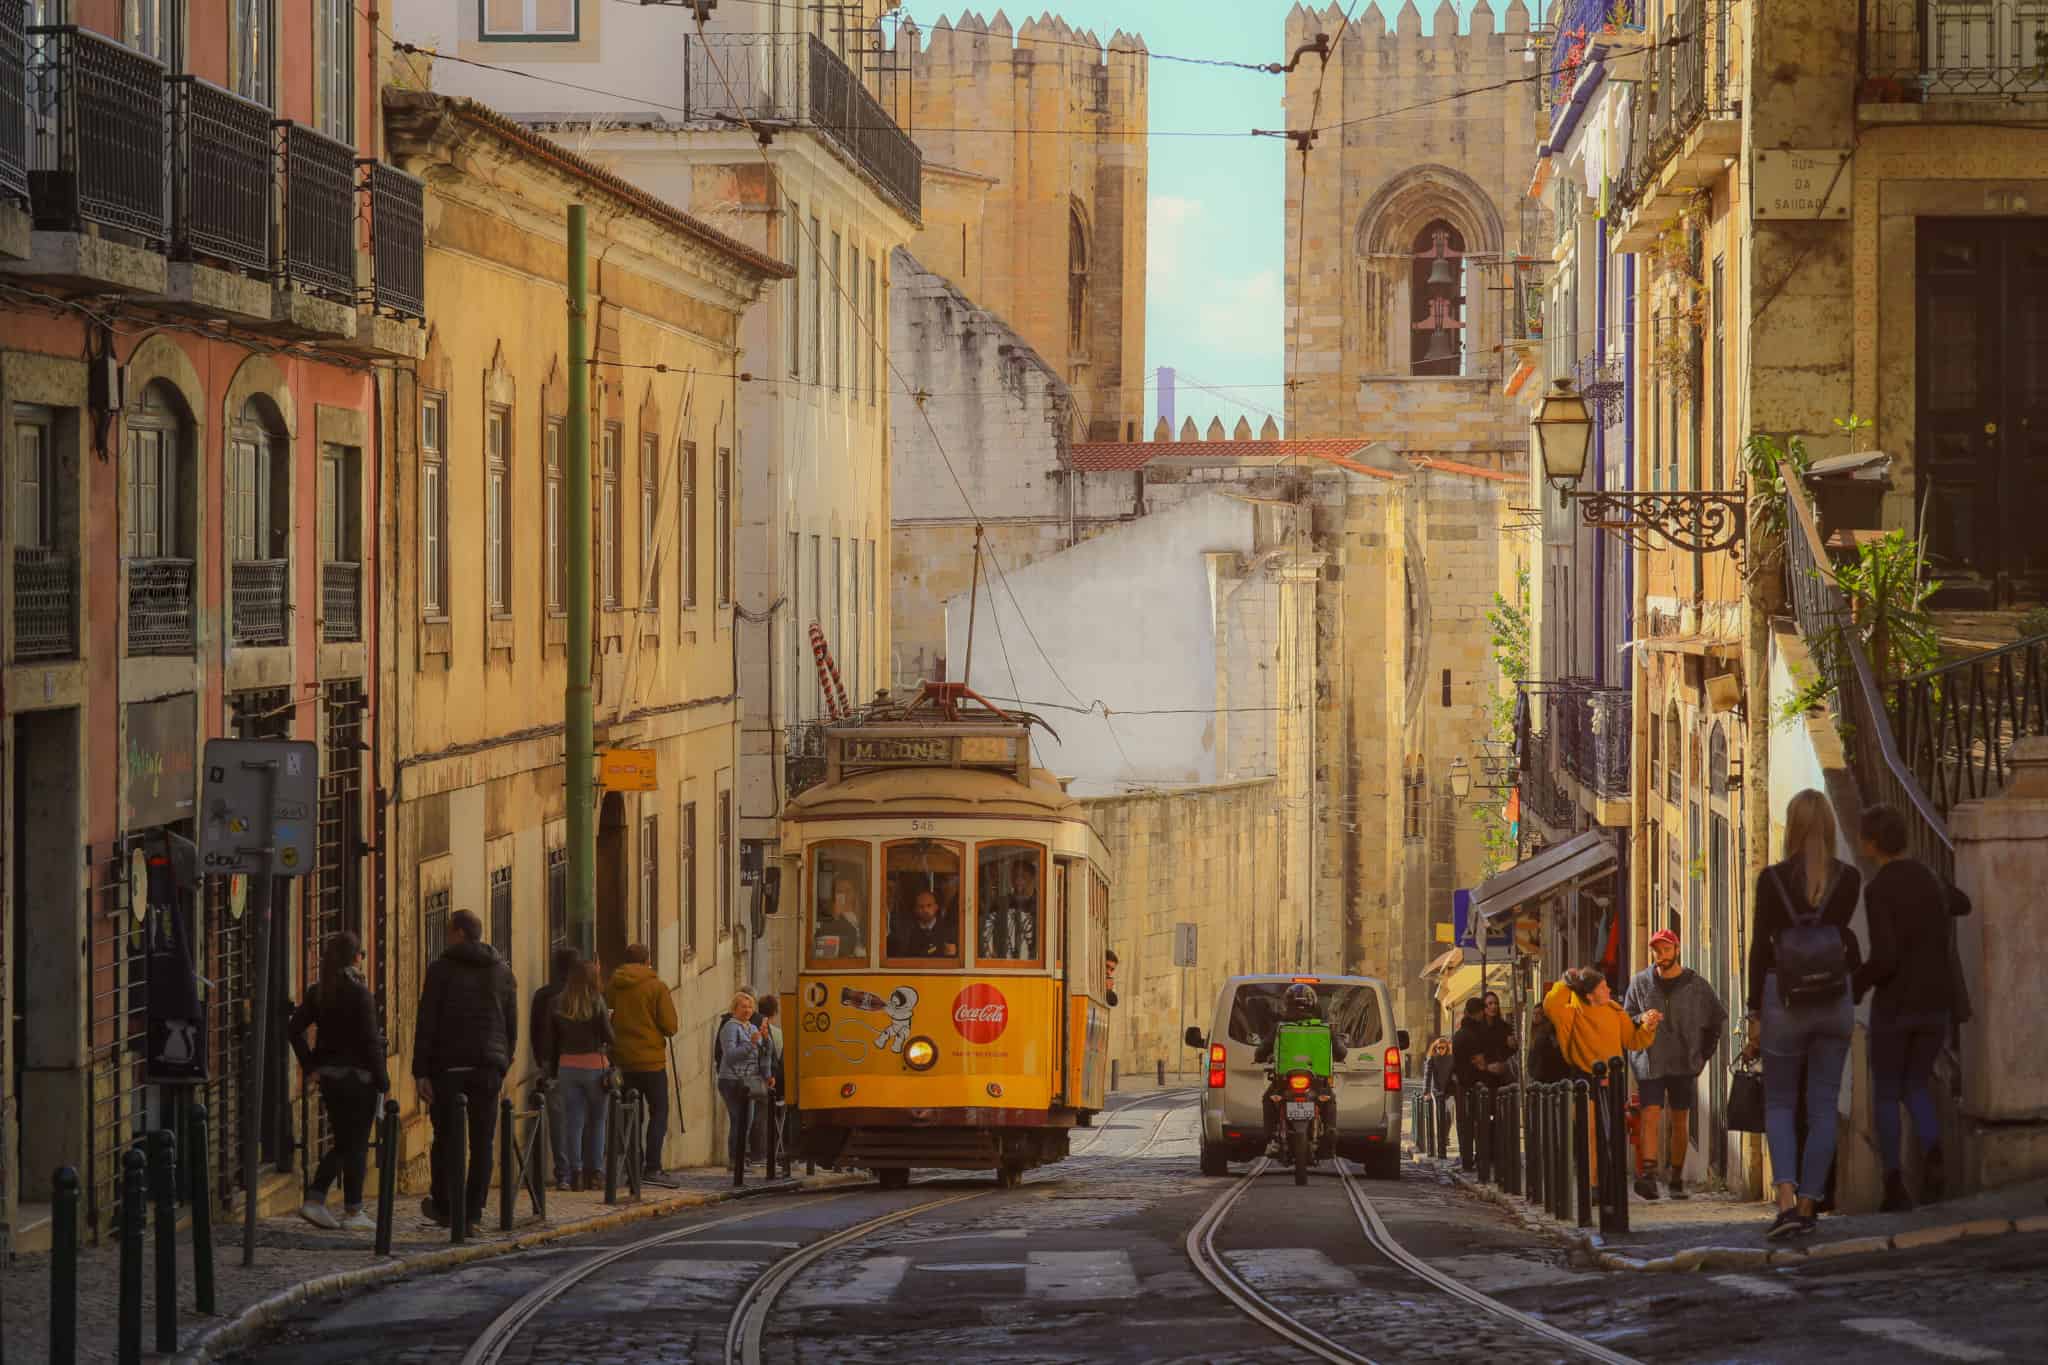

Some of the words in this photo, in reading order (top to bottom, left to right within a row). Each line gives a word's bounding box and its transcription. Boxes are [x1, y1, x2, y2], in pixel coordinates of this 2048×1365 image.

[1791, 160, 1815, 170] RUA
[1794, 178, 1811, 190] DA
[954, 1003, 1005, 1023] Coca-Cola
